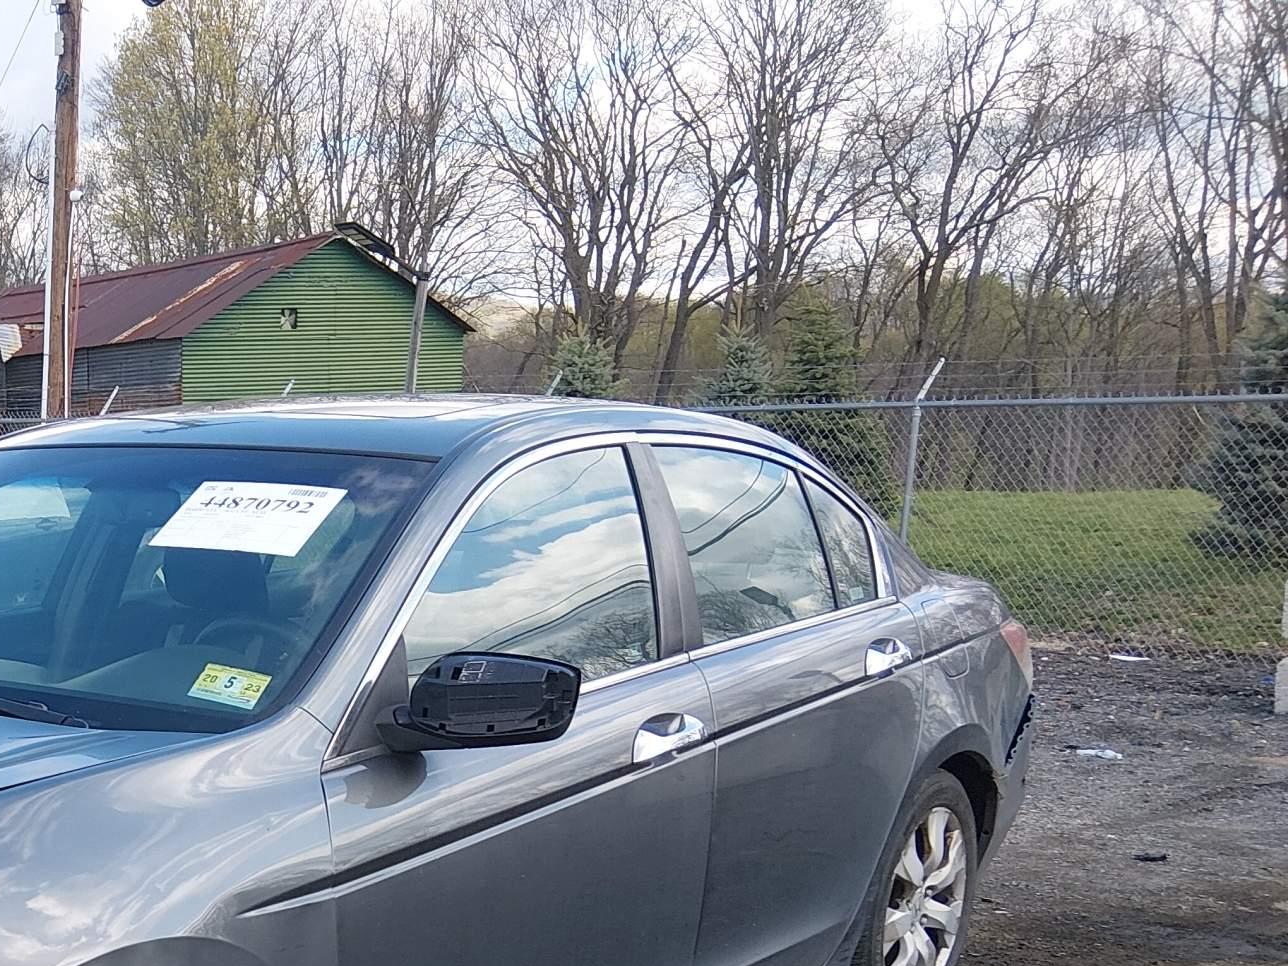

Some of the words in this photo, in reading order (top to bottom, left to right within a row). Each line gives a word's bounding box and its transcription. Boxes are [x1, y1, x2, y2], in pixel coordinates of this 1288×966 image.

[200, 496, 315, 514] 44870792
[202, 673, 219, 684] 20
[223, 676, 239, 690] 5
